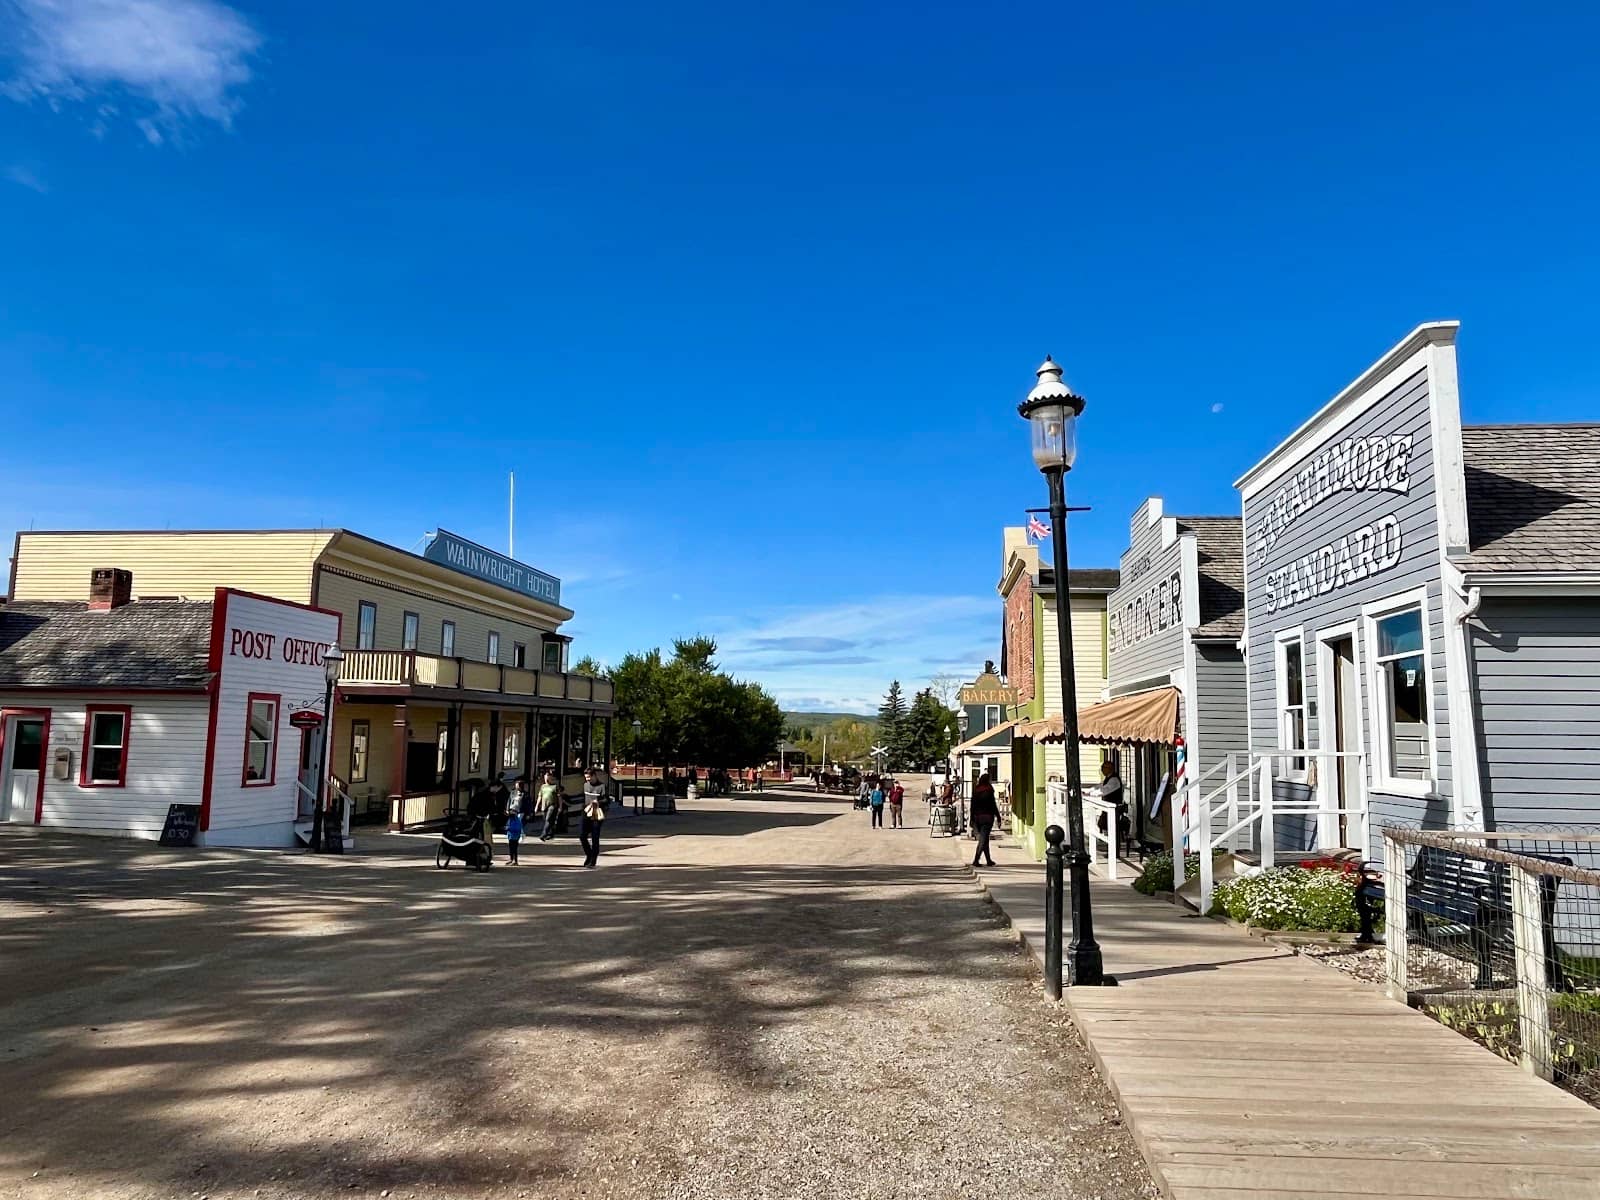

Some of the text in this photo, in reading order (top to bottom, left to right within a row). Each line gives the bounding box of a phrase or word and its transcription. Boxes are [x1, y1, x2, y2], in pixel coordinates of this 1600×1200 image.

[1251, 434, 1414, 568] STRATHMORE
[446, 540, 556, 600] WAINWRIGHT HOTEL
[1265, 512, 1402, 616] STANDARD
[230, 628, 276, 661] POST
[1109, 568, 1183, 655] SNOOKER
[963, 689, 1014, 702] BAKERY
